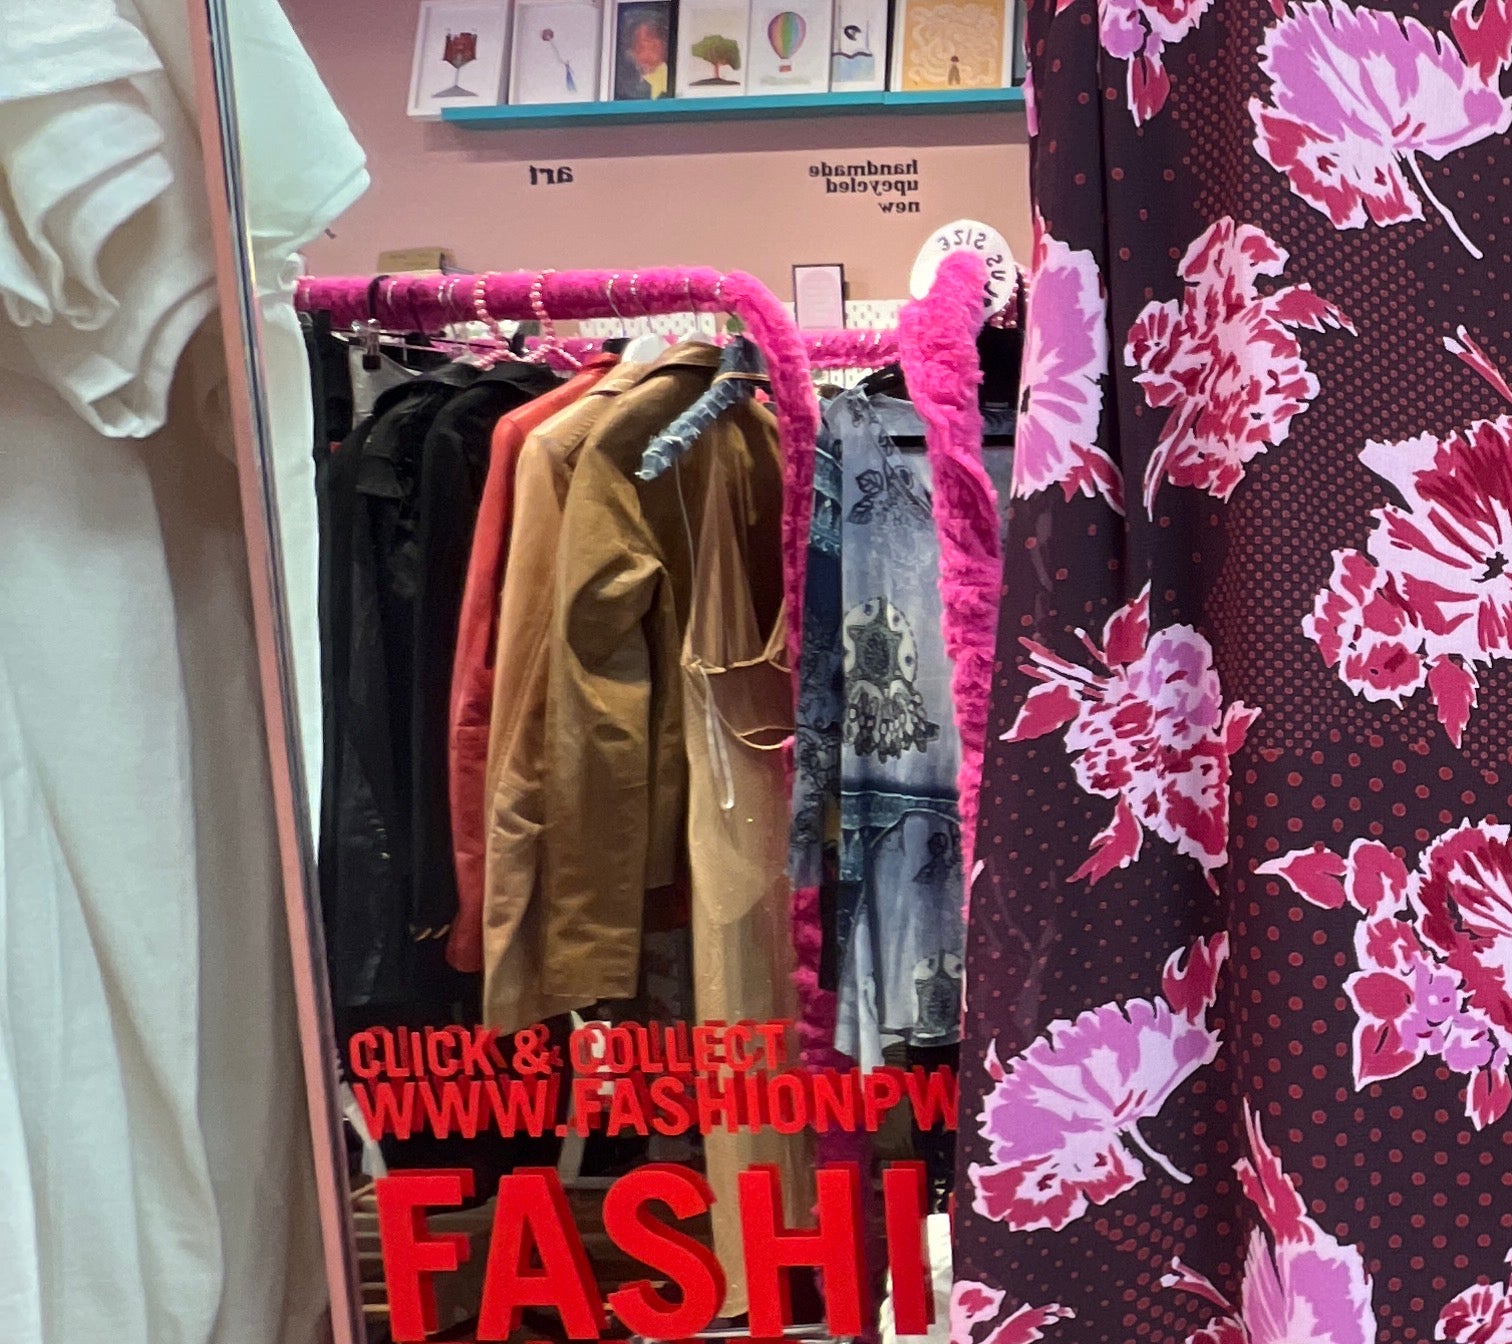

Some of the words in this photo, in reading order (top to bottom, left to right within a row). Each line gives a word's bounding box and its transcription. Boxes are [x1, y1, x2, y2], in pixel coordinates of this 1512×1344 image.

[349, 1028, 497, 1080] CLICK
[512, 1028, 554, 1076] &
[568, 1023, 786, 1076] COLLECT
